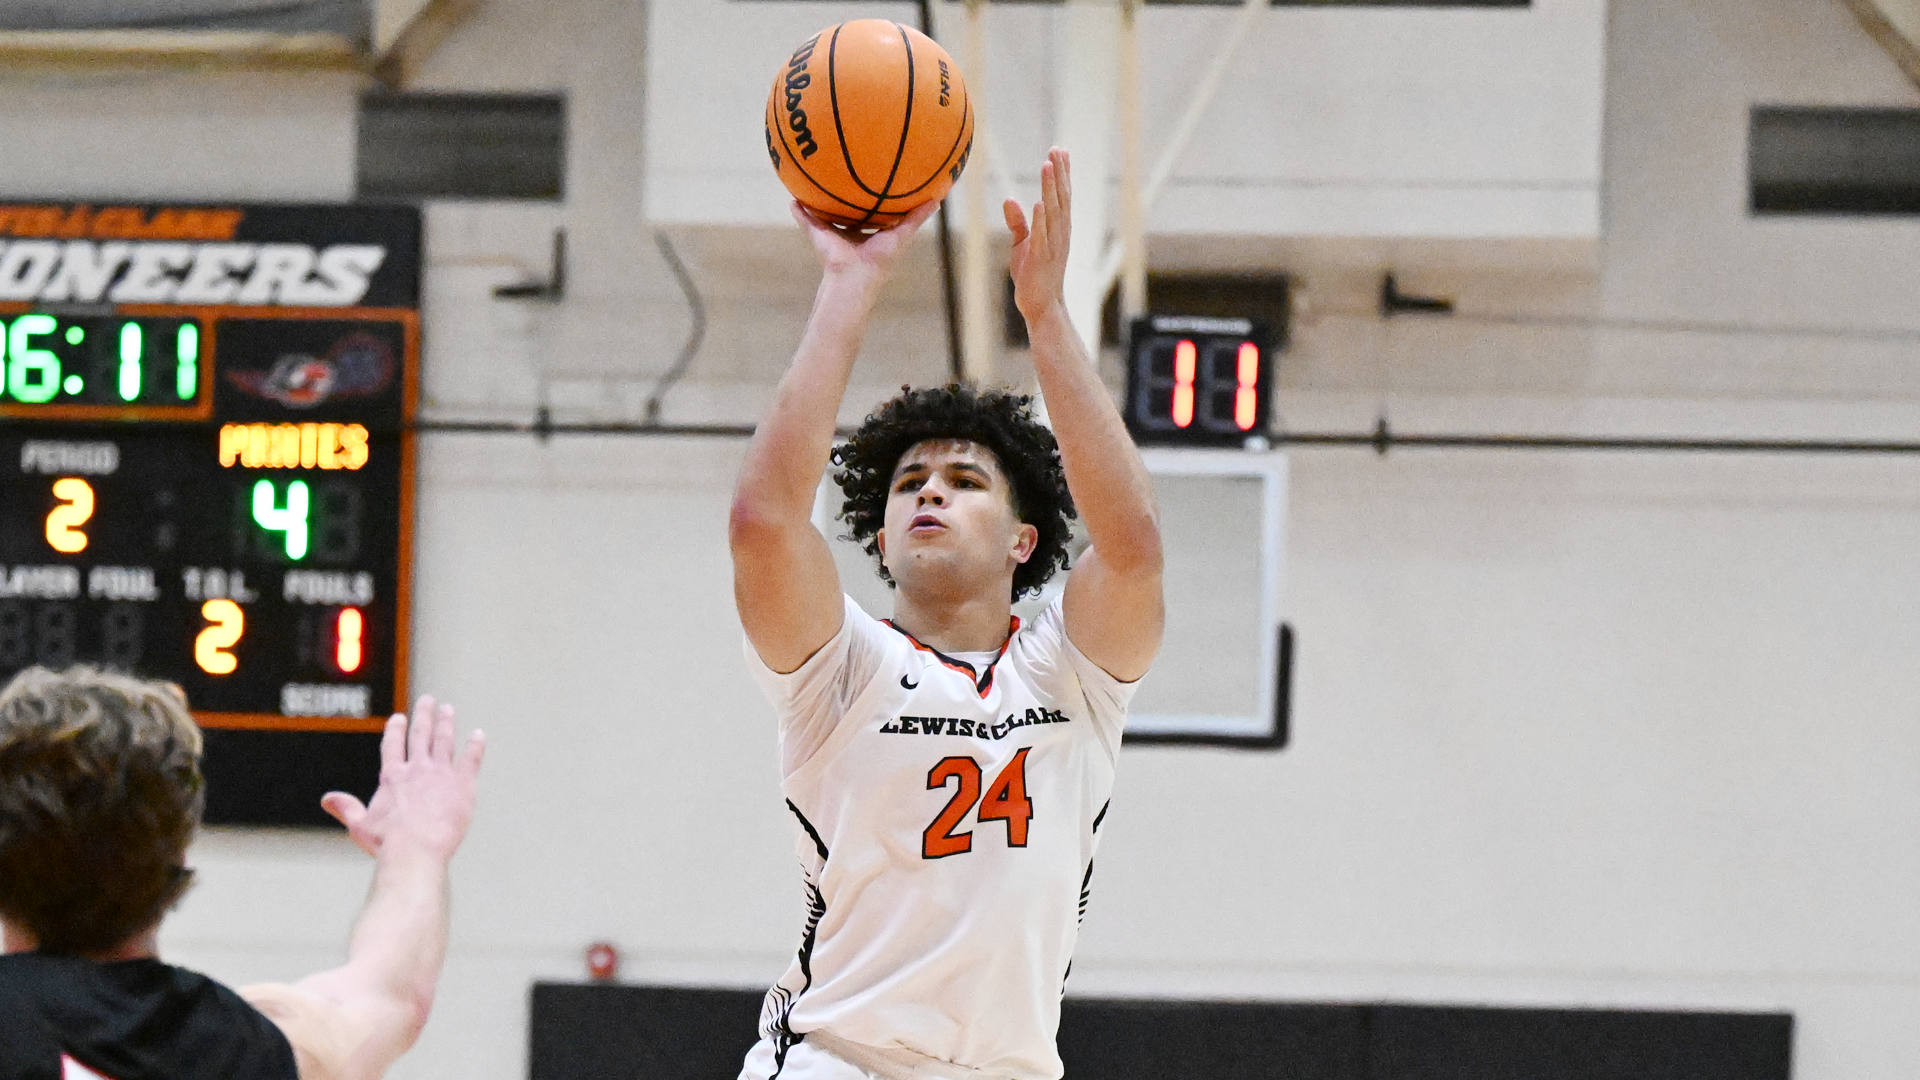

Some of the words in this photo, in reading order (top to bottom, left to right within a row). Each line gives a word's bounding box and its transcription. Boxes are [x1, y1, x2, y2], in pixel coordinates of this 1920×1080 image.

[784, 33, 819, 161] Wilson
[1171, 338, 1260, 432] 11
[45, 477, 95, 553] 2
[252, 478, 310, 560] 4
[194, 598, 244, 675] 2
[336, 607, 363, 673] 1
[921, 745, 1034, 859] 24
